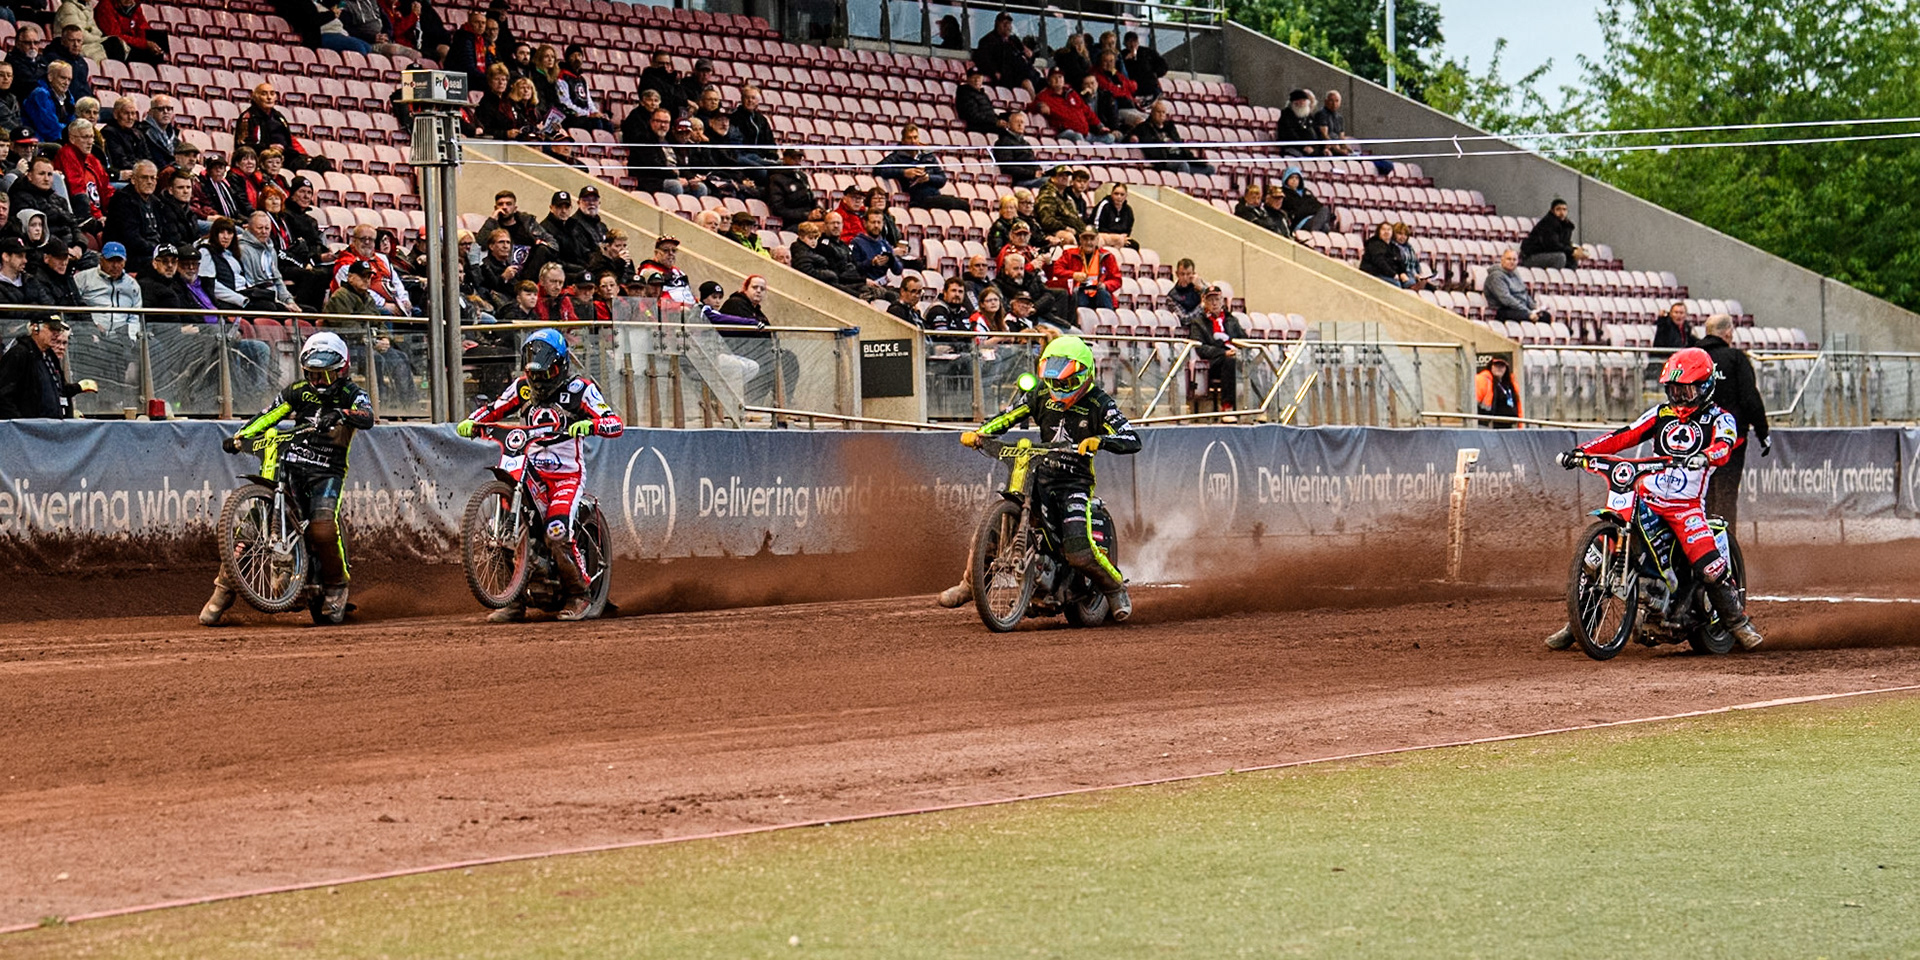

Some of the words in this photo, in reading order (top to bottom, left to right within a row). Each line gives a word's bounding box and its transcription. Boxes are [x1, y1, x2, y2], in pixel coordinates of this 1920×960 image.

[863, 343, 891, 353] BLOCK
[893, 342, 899, 352] E
[137, 476, 213, 528] what
[633, 484, 666, 516] ATPI
[700, 476, 810, 528] Delivering
[1206, 473, 1231, 499] ATPI
[1258, 465, 1342, 514] Delivering
[1345, 464, 1393, 501] what
[1396, 463, 1444, 503] really
[1760, 459, 1796, 493] what
[1800, 459, 1840, 503] really
